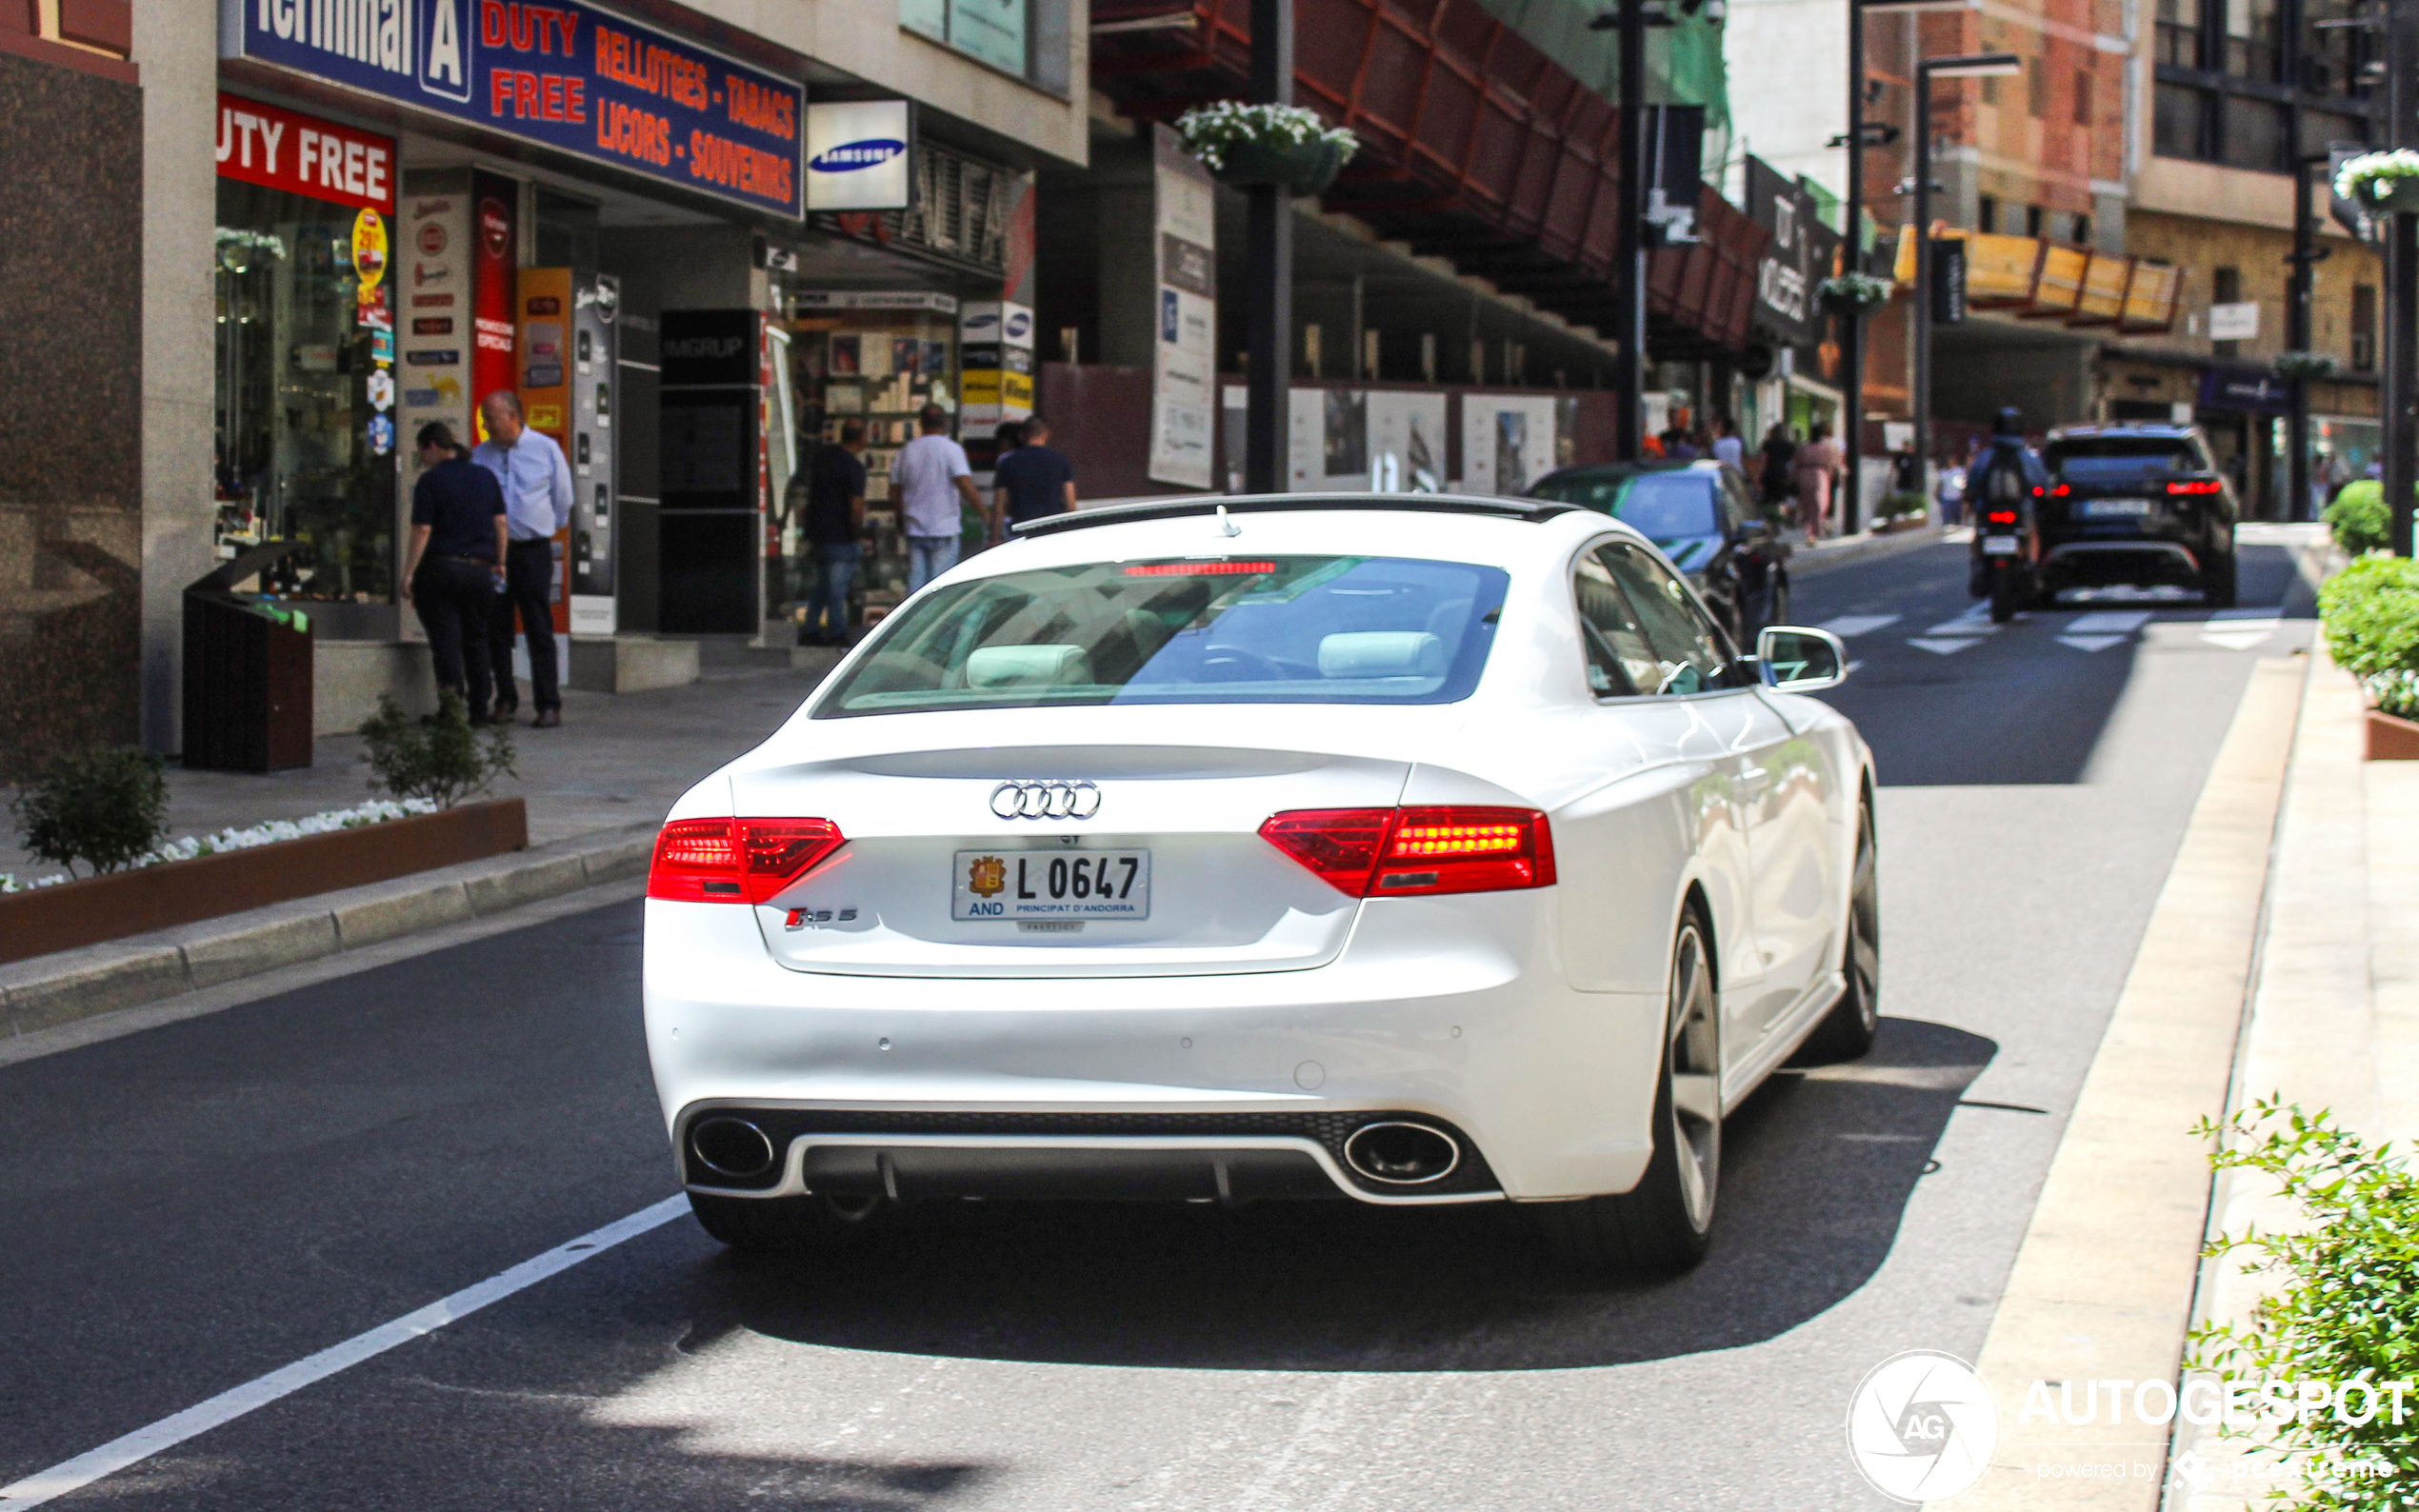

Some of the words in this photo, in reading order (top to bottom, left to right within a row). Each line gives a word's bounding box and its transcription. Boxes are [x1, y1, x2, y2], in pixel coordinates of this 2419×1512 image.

[429, 0, 463, 87] A
[481, 0, 579, 57] DUTY
[490, 68, 586, 124] FREE
[595, 25, 708, 111] RELLOTGES
[726, 74, 795, 140] TABACS
[216, 108, 284, 174] UTY
[299, 129, 387, 201] FREE
[596, 97, 670, 167] LICORS
[690, 129, 793, 205] SOUVENIRS
[820, 147, 895, 164] SAMSUNG
[1017, 858, 1036, 899] L
[1049, 857, 1138, 899] 0647
[969, 903, 1004, 916] AND
